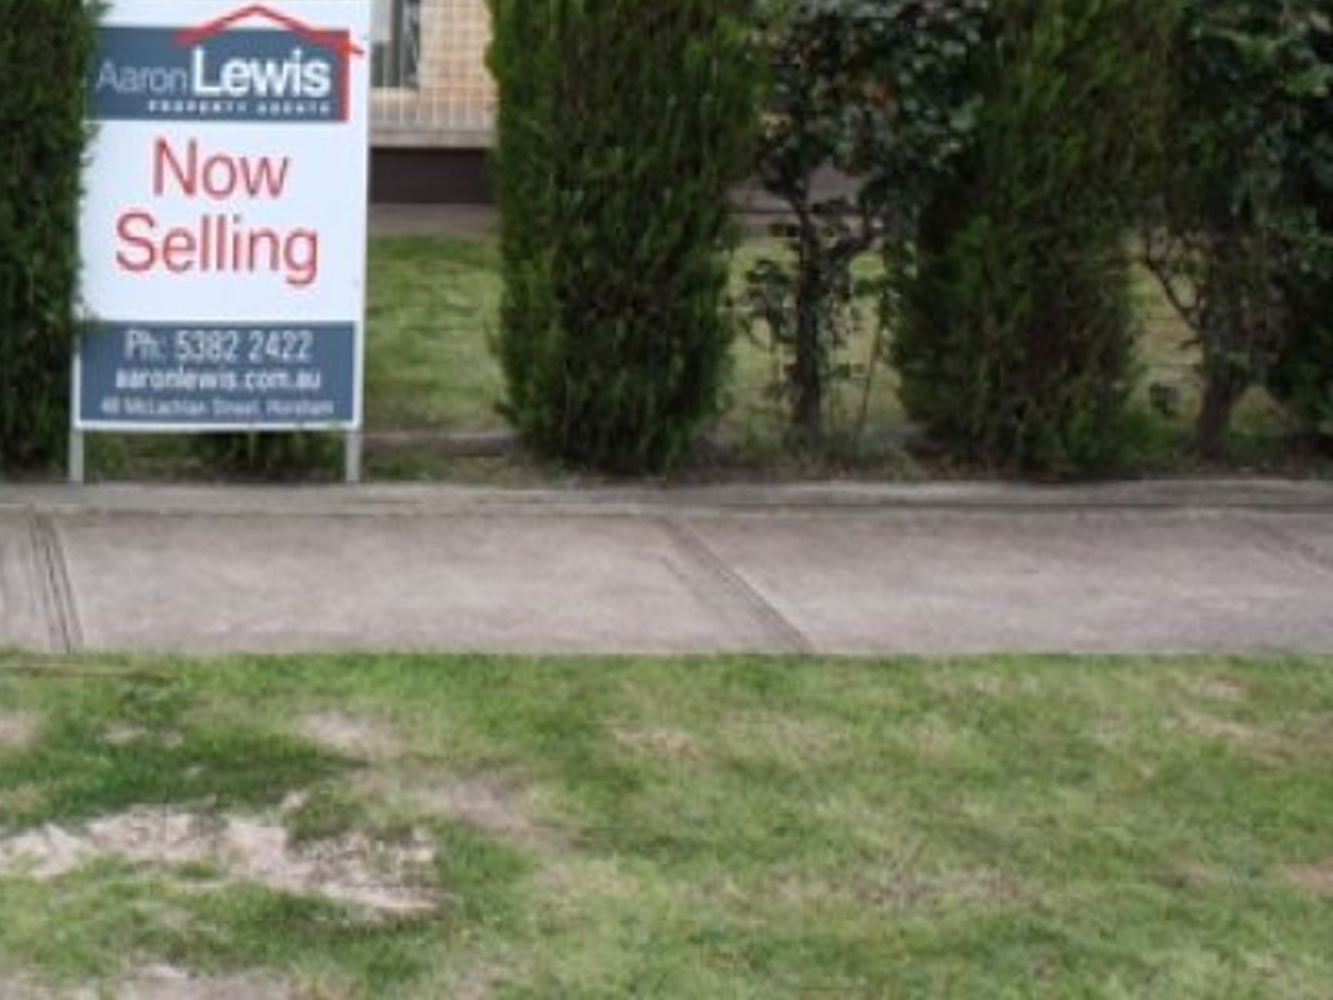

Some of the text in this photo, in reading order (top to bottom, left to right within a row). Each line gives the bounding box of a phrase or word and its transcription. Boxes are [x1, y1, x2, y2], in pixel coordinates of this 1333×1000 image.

[96, 47, 332, 97] Aaron Lewis
[152, 137, 290, 199] Now
[114, 211, 319, 285] Selling
[177, 330, 238, 362] 5382
[248, 330, 314, 363] 2422
